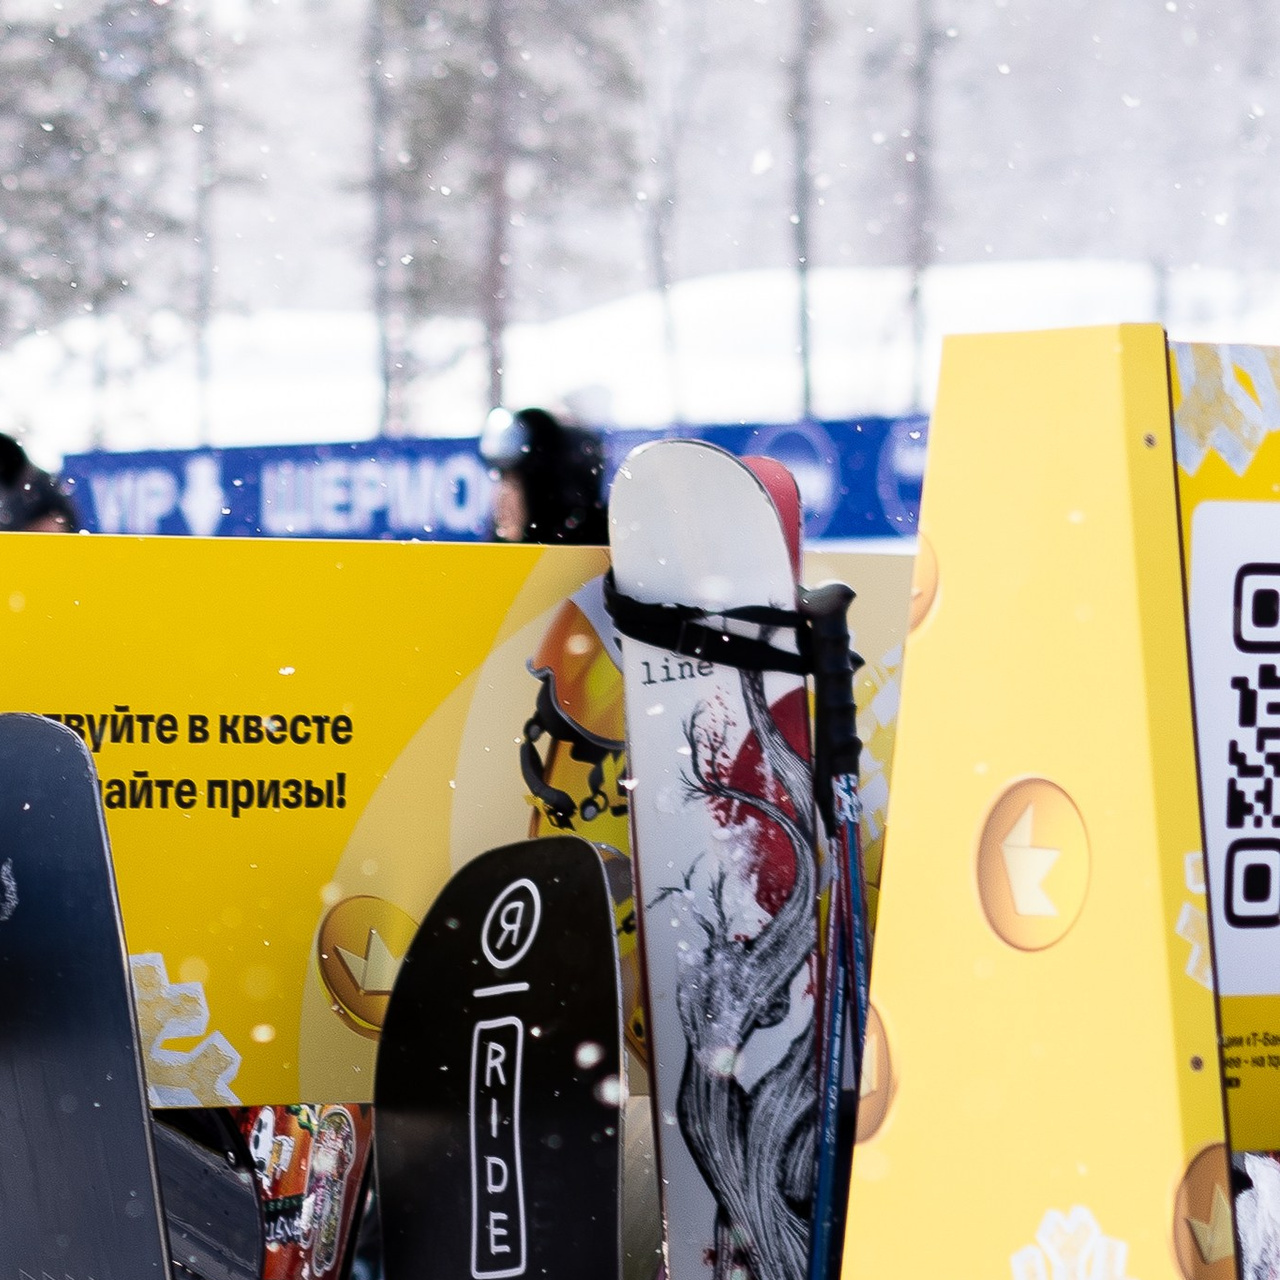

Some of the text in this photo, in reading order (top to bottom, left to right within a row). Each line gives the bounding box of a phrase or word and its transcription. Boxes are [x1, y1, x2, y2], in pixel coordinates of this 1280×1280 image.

[640, 656, 715, 686] line
[188, 713, 210, 745] в
[219, 712, 353, 746] квесте
[206, 772, 347, 818] призы!
[484, 1041, 511, 1255] RIDE
